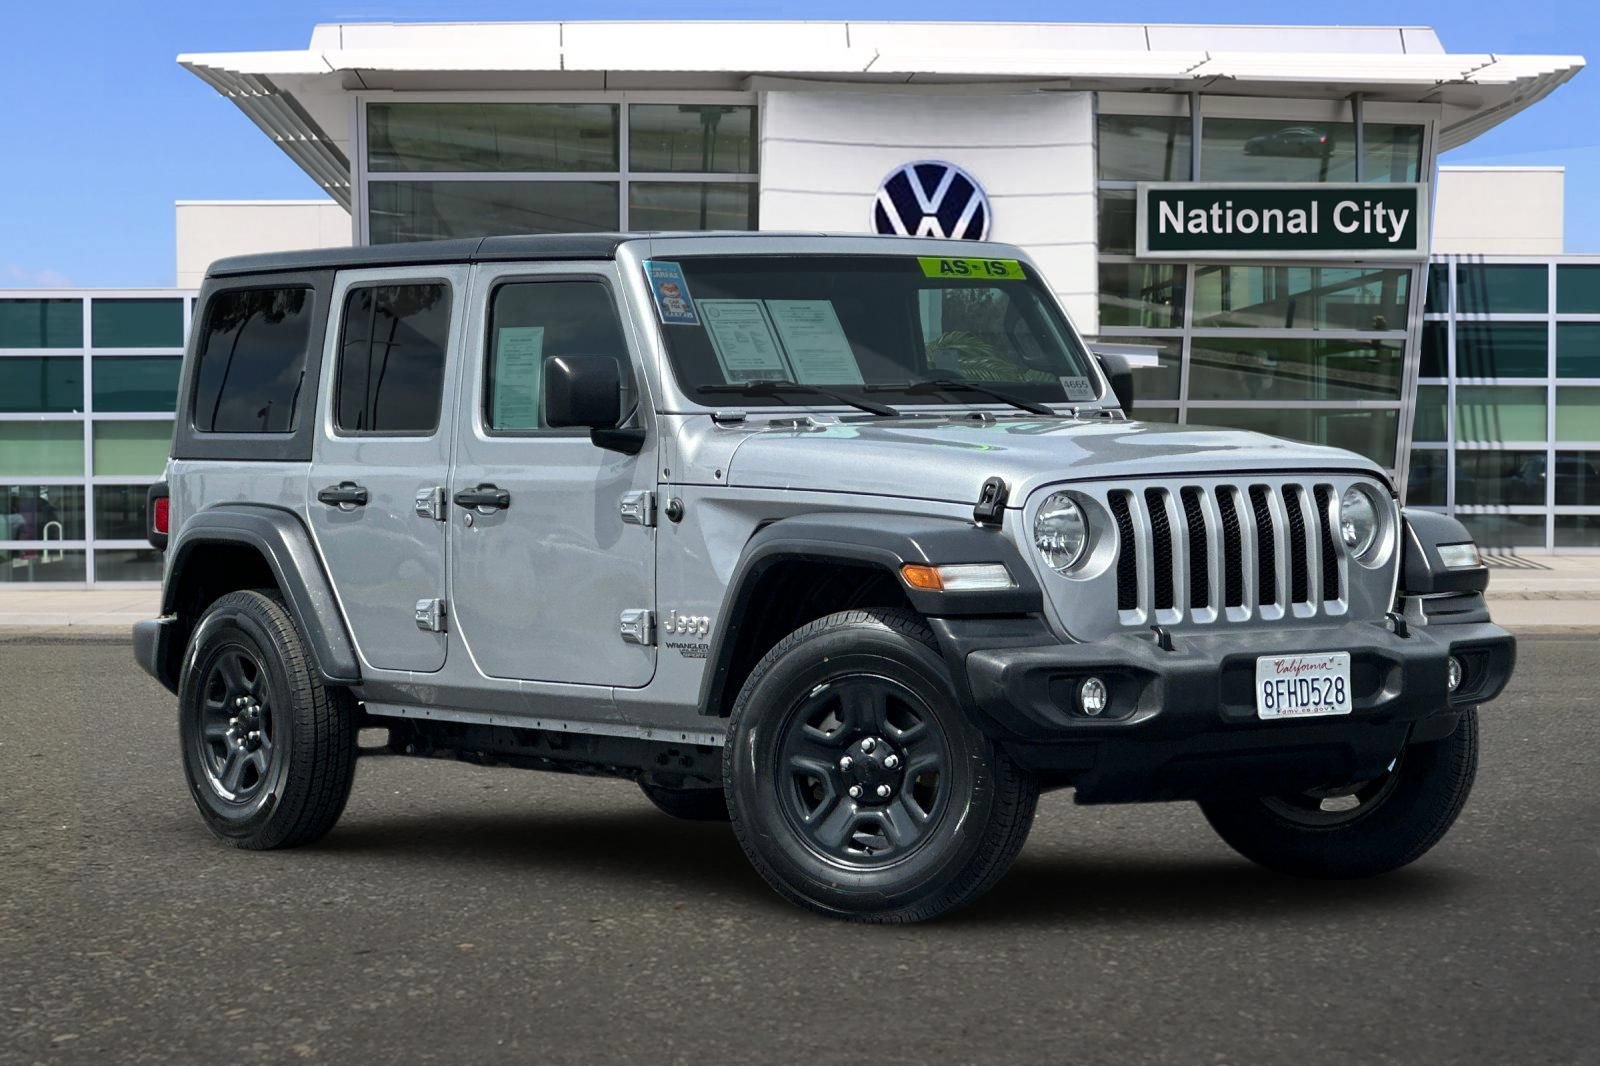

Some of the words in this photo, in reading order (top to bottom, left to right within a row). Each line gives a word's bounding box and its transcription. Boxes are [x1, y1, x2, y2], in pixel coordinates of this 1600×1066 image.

[1158, 200, 1318, 235] National
[1332, 200, 1410, 243] City
[663, 609, 710, 640] Jeep
[665, 641, 709, 650] WRANGLER
[1275, 659, 1334, 677] California
[1263, 676, 1345, 709] 8FHD528
